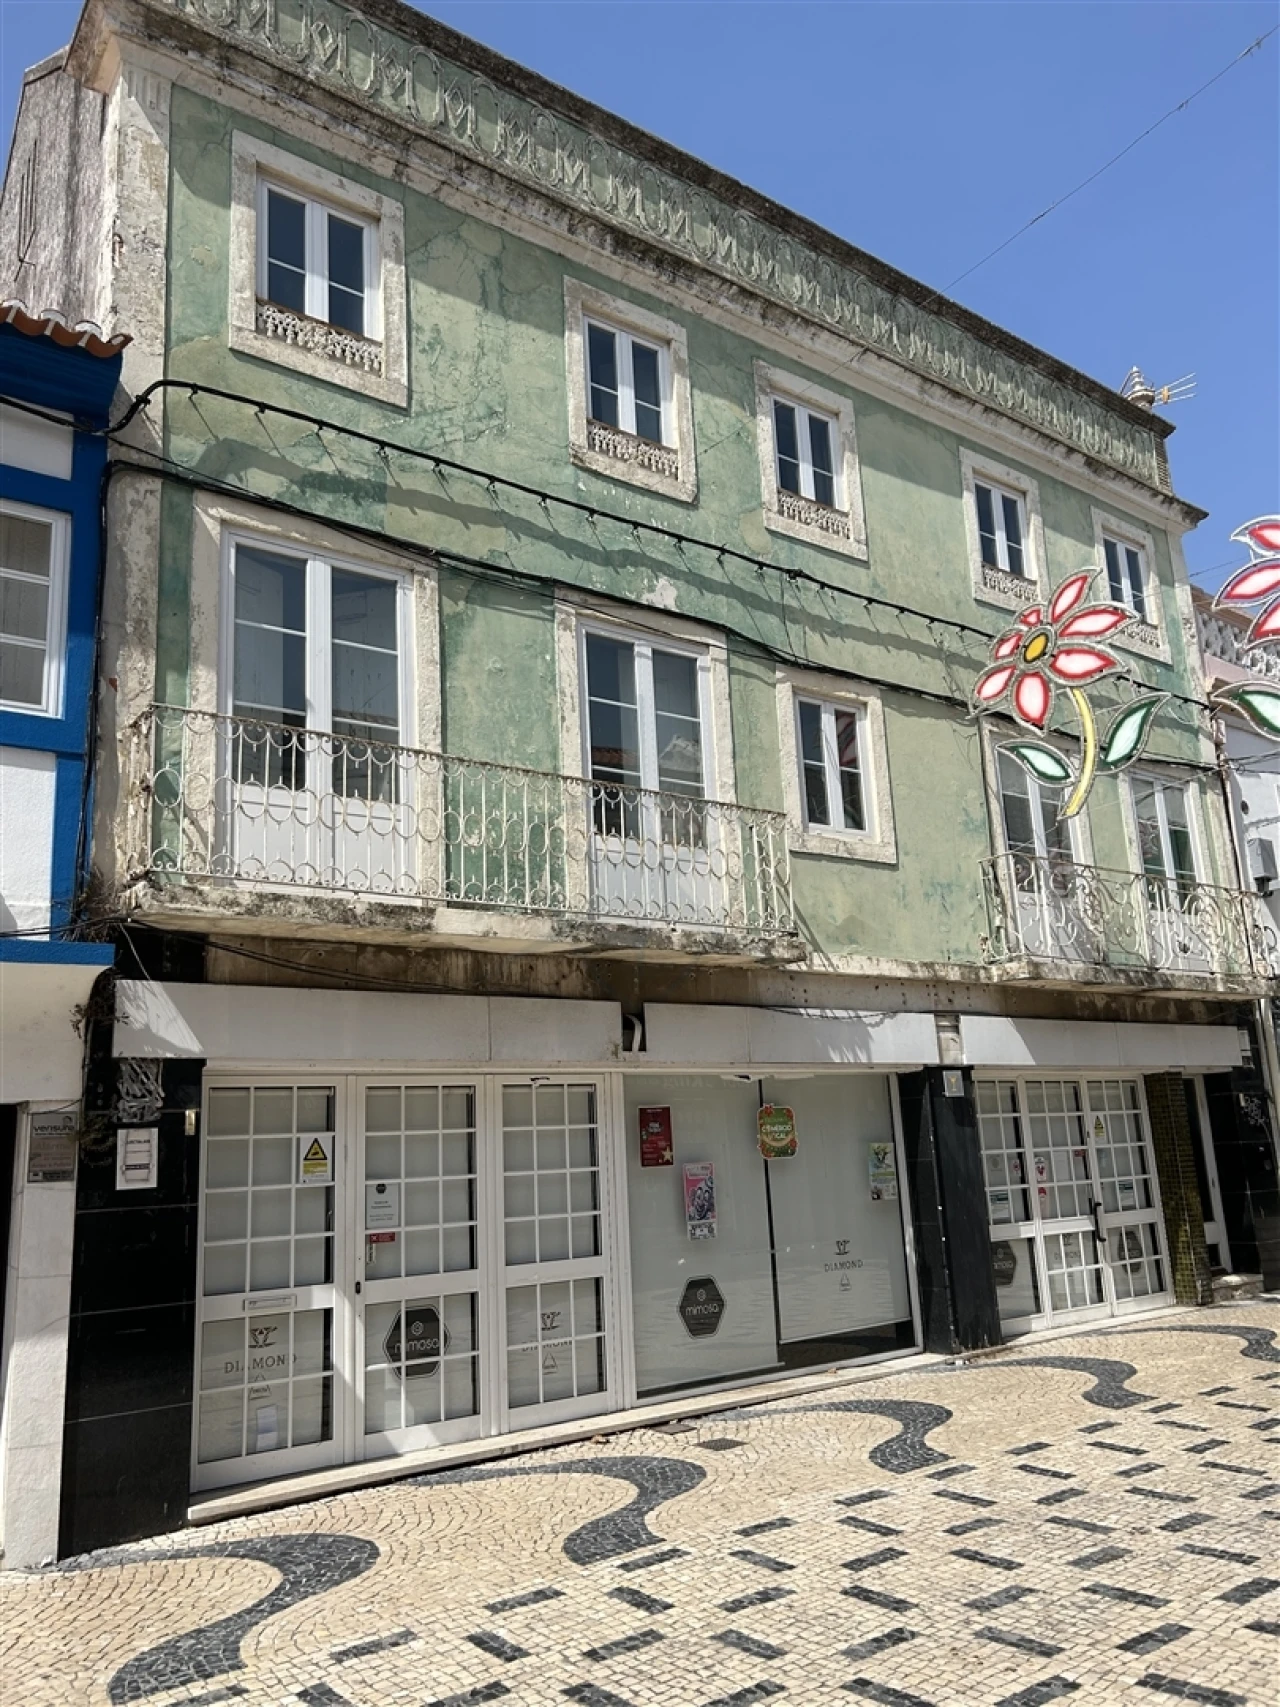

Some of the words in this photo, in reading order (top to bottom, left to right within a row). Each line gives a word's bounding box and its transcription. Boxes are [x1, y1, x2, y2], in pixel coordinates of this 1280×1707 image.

[823, 1259, 864, 1273] DIAMOND
[685, 1303, 720, 1316] mimosa
[394, 1338, 441, 1354] mmosa
